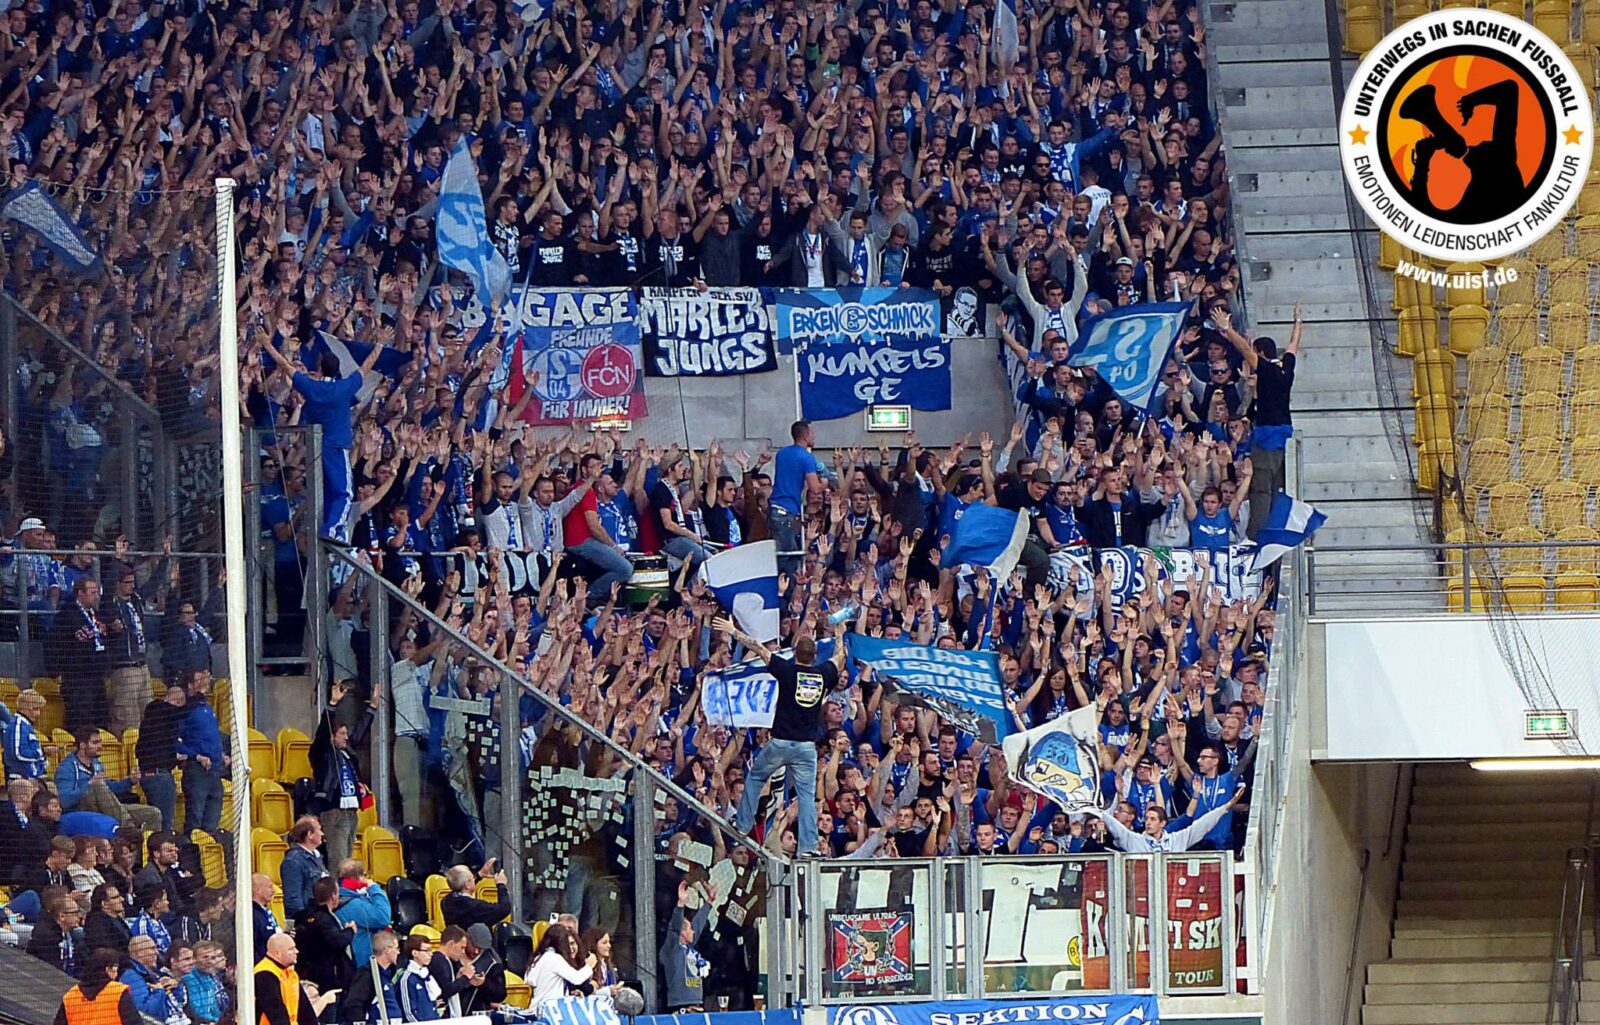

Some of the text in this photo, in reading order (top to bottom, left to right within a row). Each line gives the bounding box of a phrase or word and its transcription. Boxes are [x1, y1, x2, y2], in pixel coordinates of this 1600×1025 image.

[639, 297, 768, 340] MARLER
[791, 305, 841, 333] ERKEN
[550, 327, 613, 348] FREUNDE
[656, 332, 767, 376] JUNGS
[807, 346, 945, 383] KUMPELS
[587, 364, 631, 388] FCN
[854, 377, 902, 404] GE
[541, 395, 631, 420] FÜR IMMER!
[872, 911, 897, 920] ULTRAS
[1175, 969, 1213, 984] TOUR
[930, 1003, 1110, 1025] SEKTION
